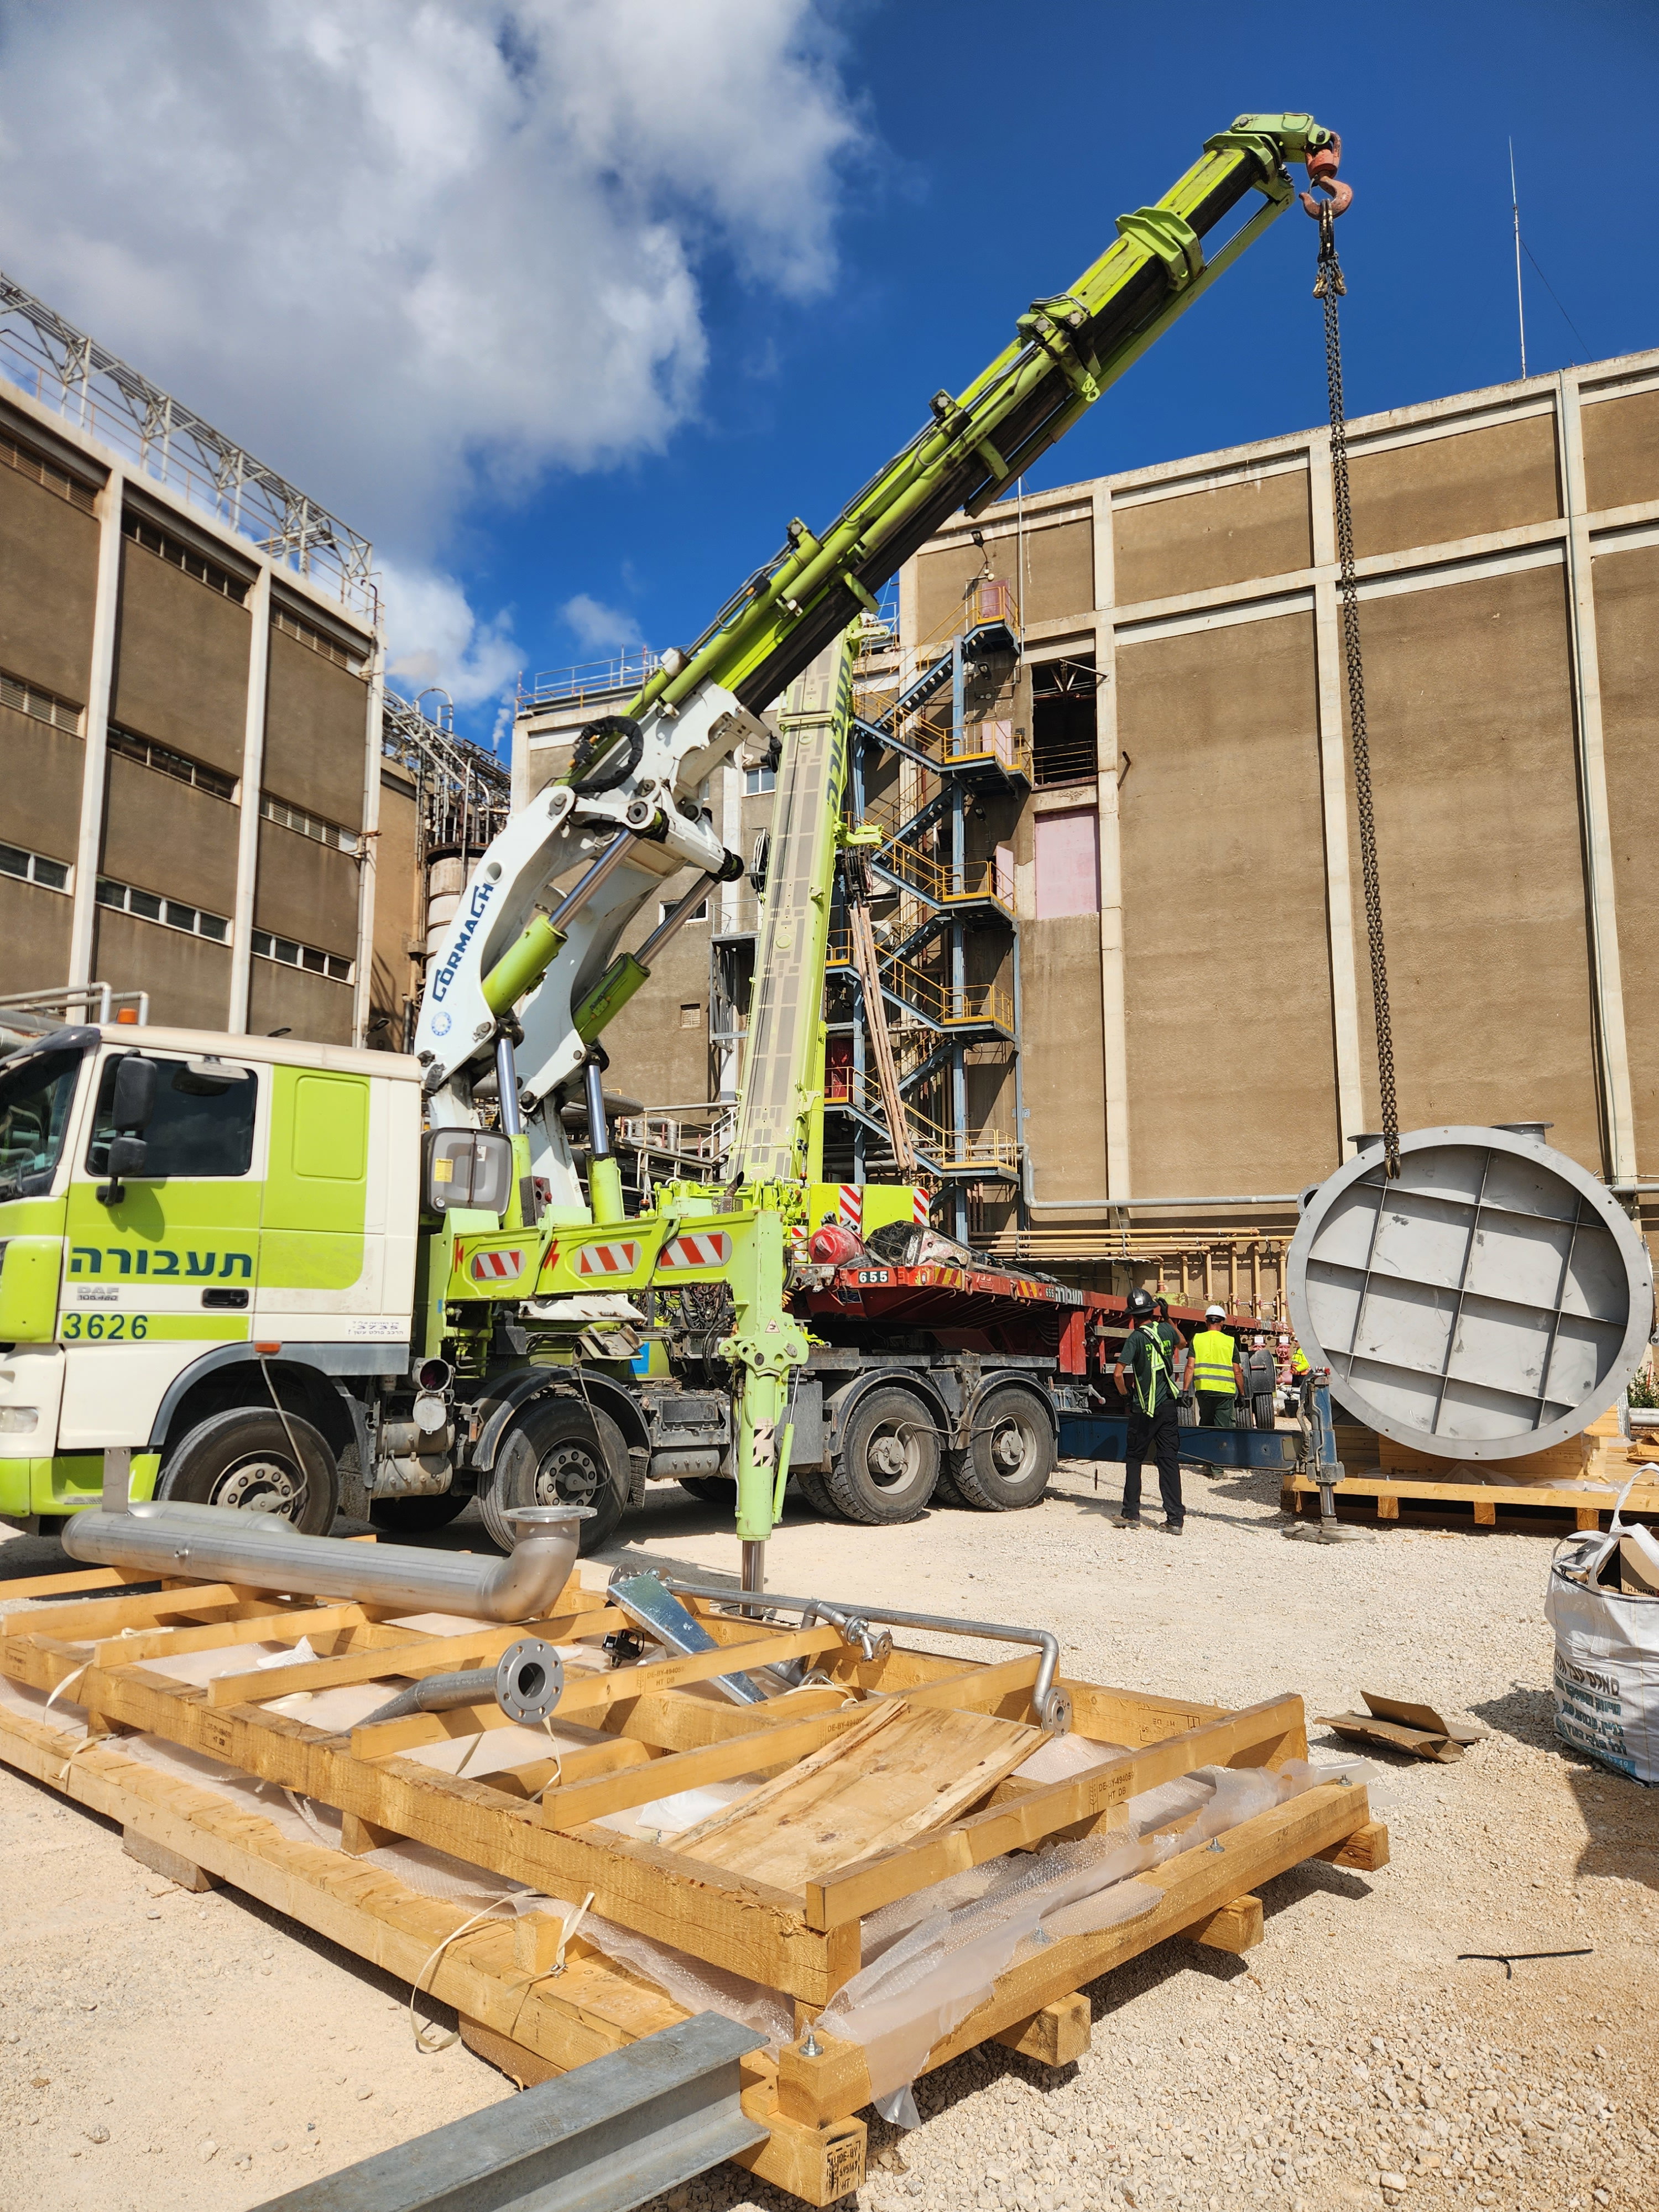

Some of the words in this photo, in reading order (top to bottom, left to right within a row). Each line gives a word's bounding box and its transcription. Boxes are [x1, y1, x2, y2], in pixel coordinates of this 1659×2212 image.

[432, 883, 494, 1002] CORMACH
[70, 1247, 252, 1277] תעבורה
[859, 1271, 888, 1283] 655
[1045, 1287, 1054, 1298] 655
[1055, 1286, 1083, 1305] תעברה
[63, 1313, 148, 1340] 3626
[1108, 1790, 1116, 1801] HT
